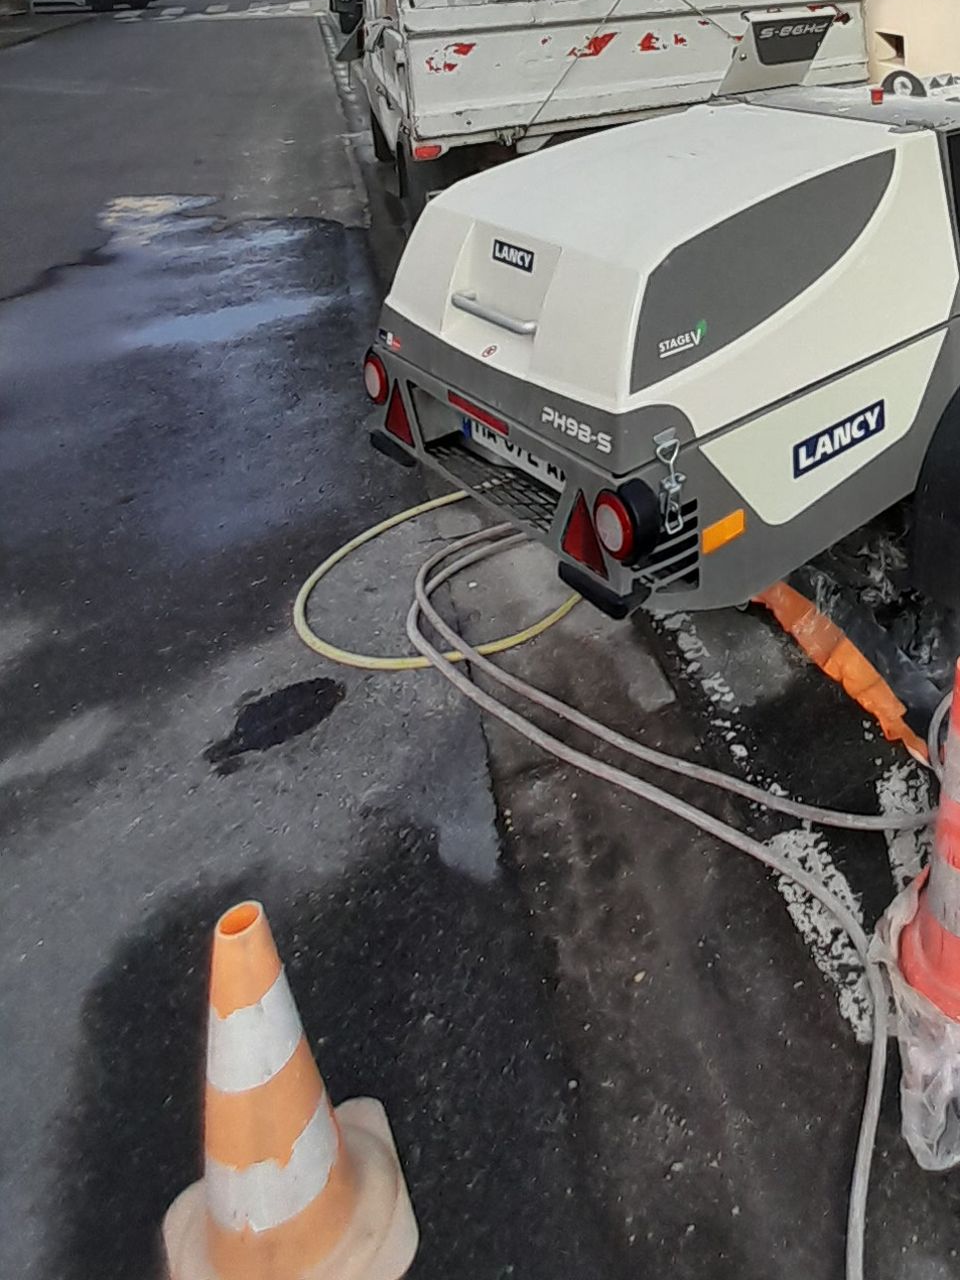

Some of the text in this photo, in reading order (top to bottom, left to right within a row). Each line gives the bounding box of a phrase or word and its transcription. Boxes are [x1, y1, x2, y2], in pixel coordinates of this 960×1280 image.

[495, 242, 532, 268] LANCY
[658, 333, 691, 352] STAGE
[798, 405, 881, 470] LANCY
